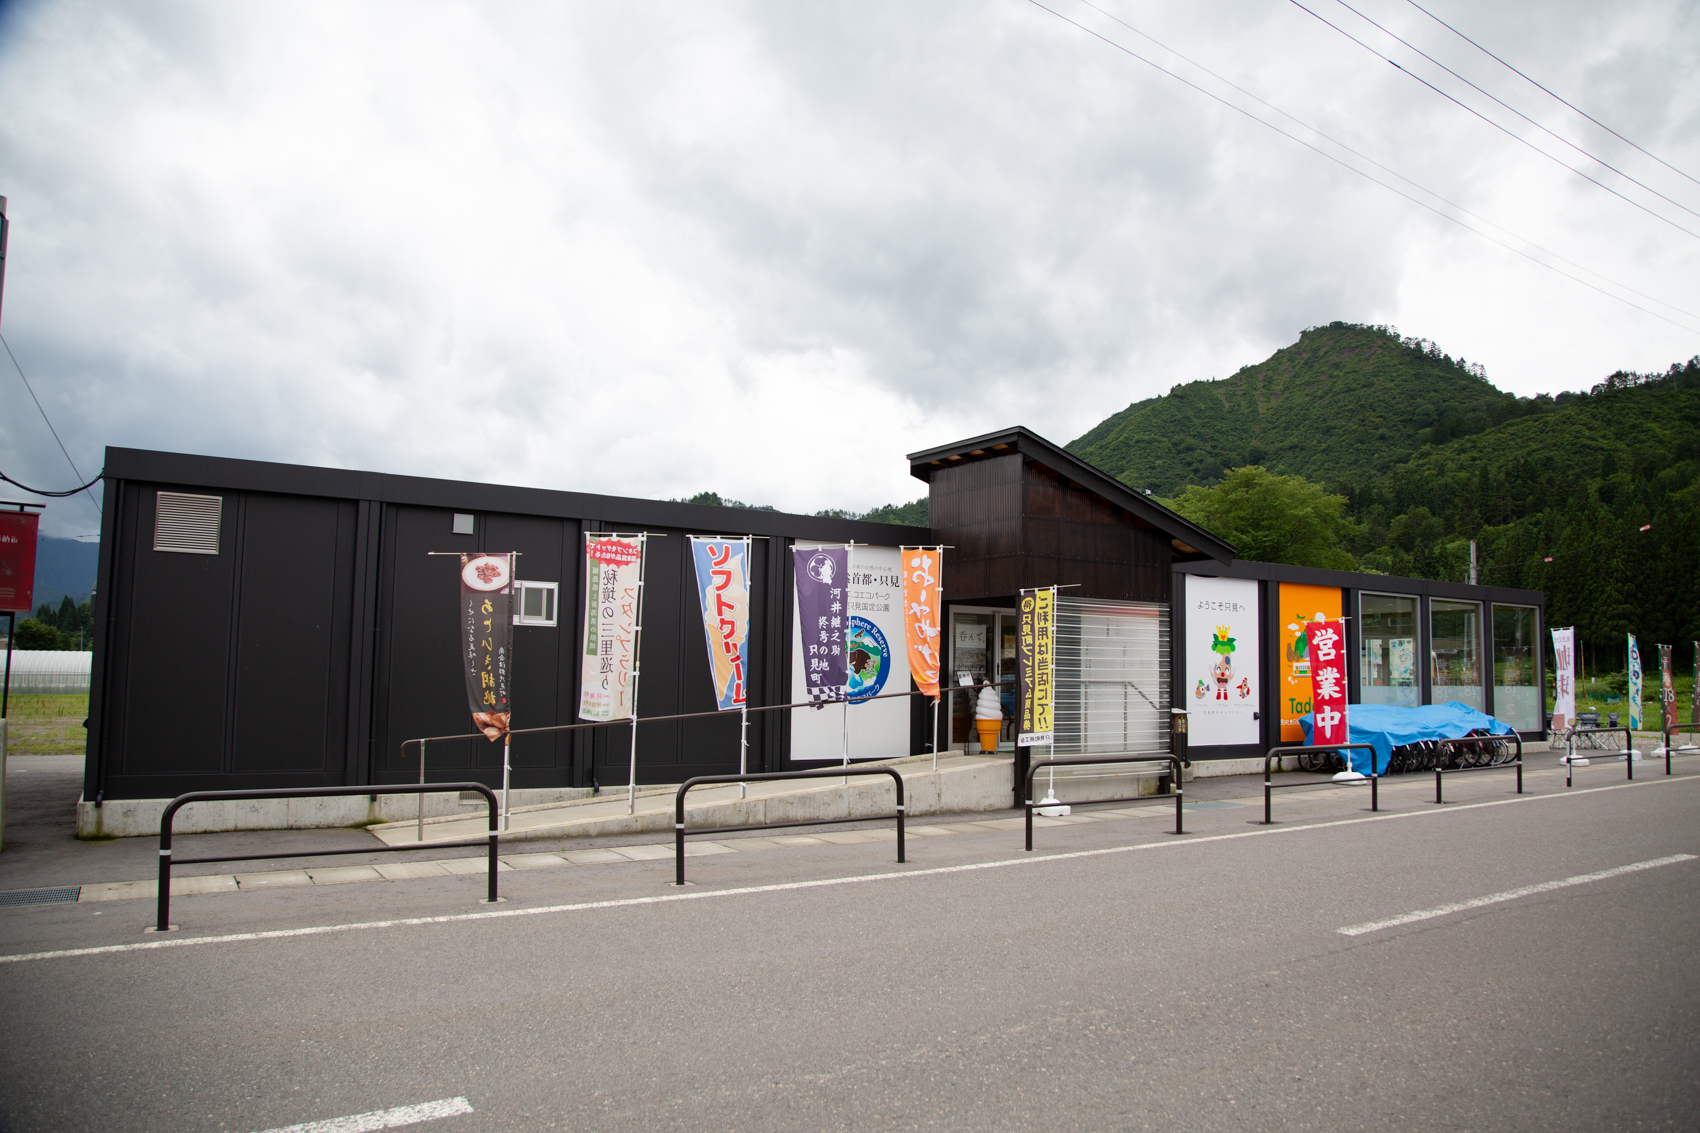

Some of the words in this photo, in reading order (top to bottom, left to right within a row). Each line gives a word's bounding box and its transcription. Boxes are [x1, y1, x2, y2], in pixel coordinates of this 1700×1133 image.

[708, 545, 747, 704] ソフトクリーム
[830, 588, 842, 656] 河井継之助
[1197, 600, 1246, 612] ようこそ只見へ
[809, 644, 822, 684] 只見町
[848, 617, 872, 631] phere
[871, 626, 888, 658] Reserve
[1312, 628, 1342, 739] 営業中
